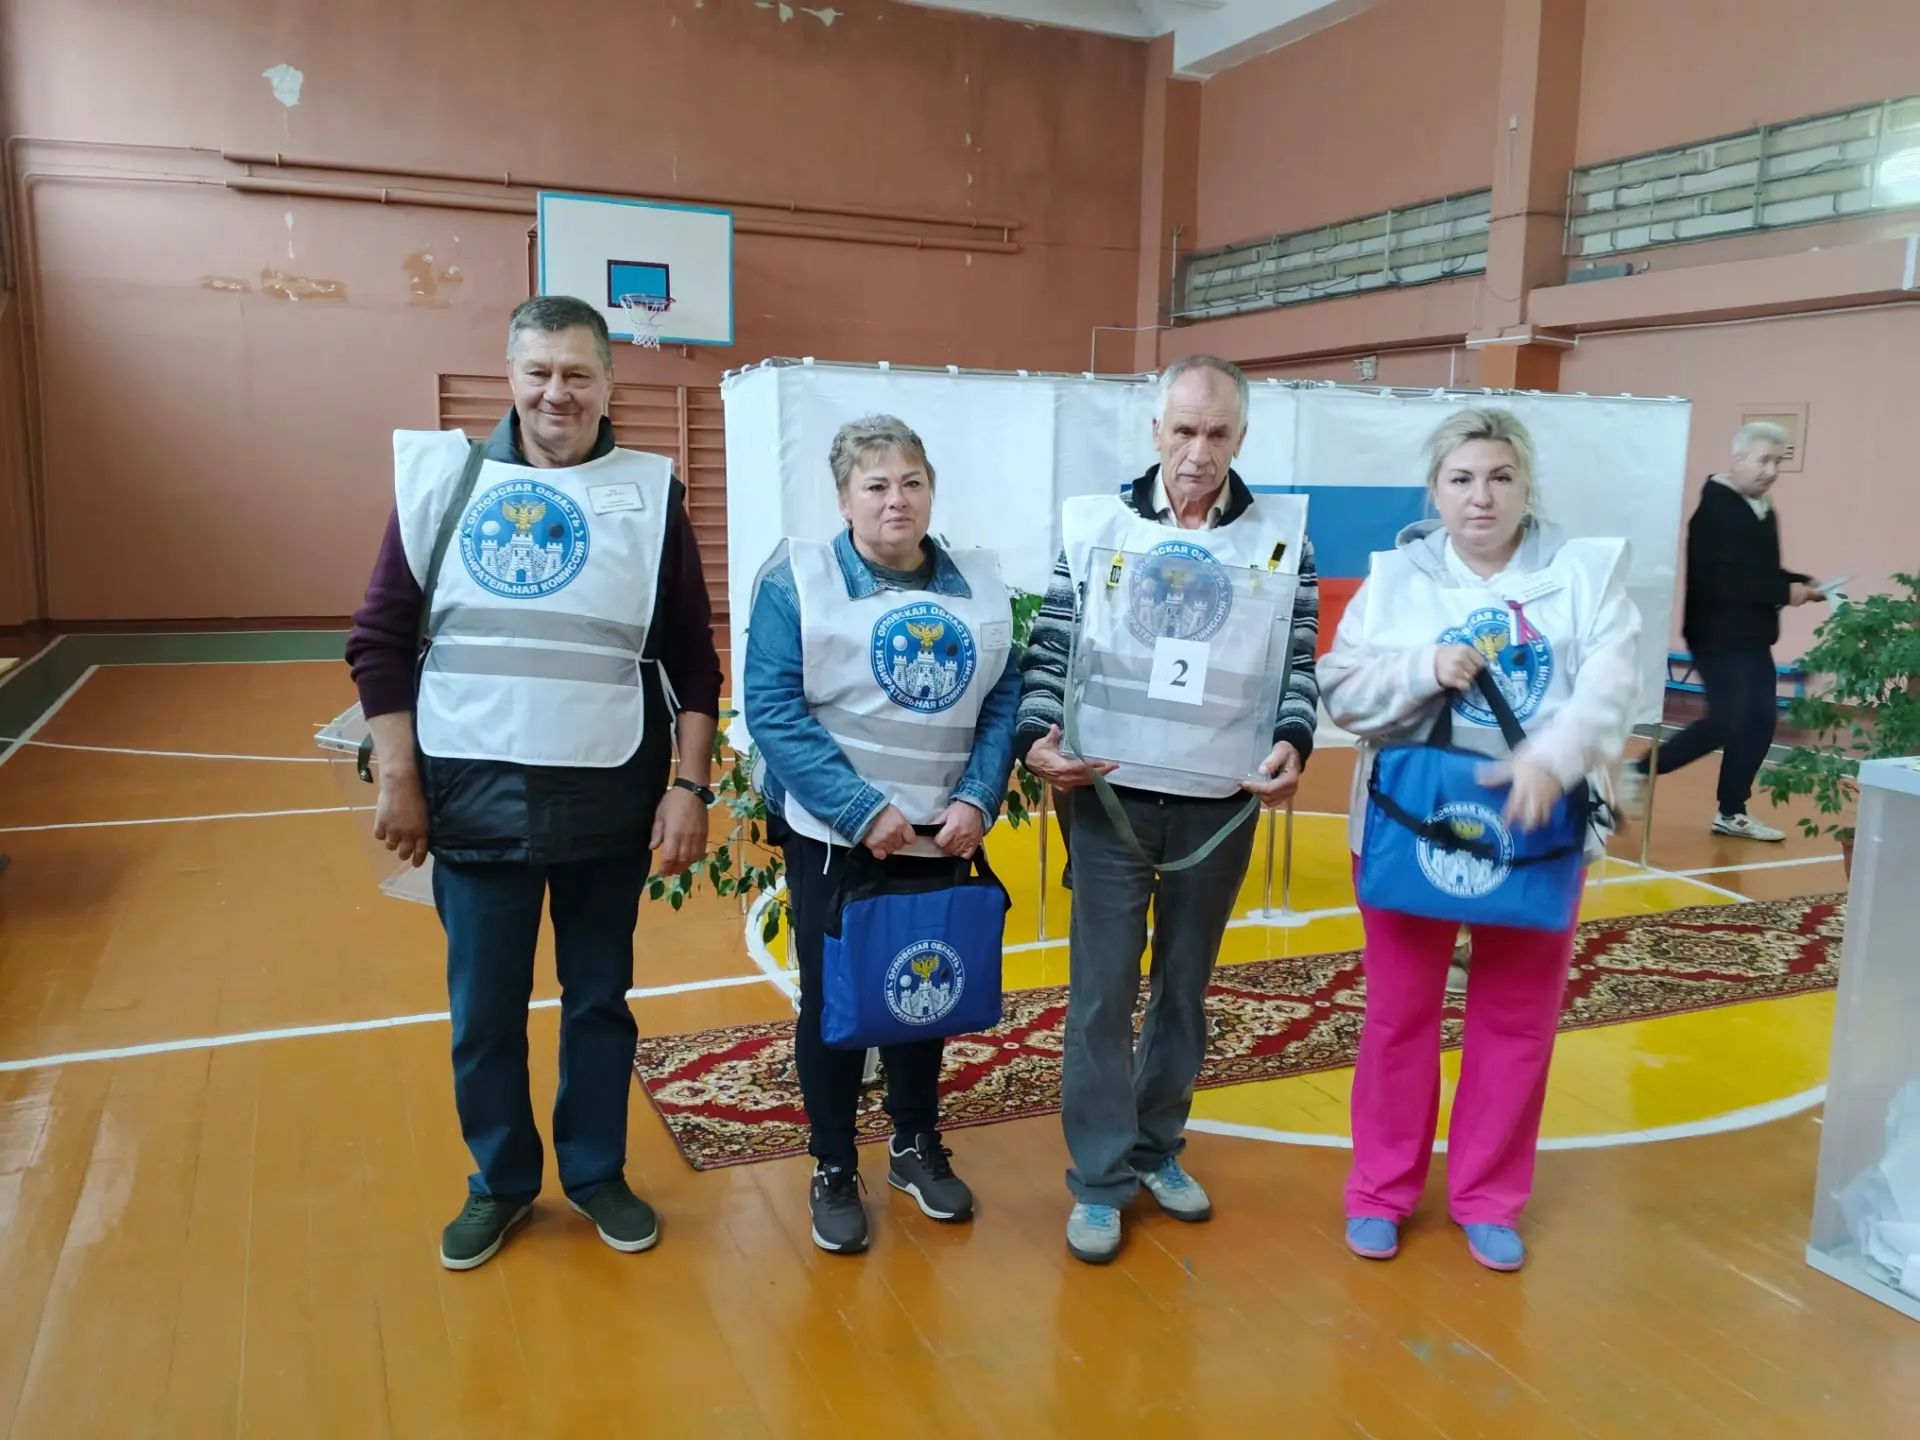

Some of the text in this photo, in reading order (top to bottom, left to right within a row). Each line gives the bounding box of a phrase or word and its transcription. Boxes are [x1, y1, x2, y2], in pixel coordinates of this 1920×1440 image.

[467, 483, 533, 525] ОРЛОВСКАЯ
[535, 486, 580, 528] ОБЛАСТЬ
[462, 537, 585, 594] ИЗБИРАТЕЛЬНАЯ КОМИССИЯ
[878, 606, 927, 637] ОРЛОВСКАЯ
[930, 607, 970, 646] ОБЛАСТЬ
[1192, 600, 1229, 641] ОМИССИЯ
[874, 649, 973, 709] ИЗБИРАТЕЛЬНАЯ КОМИССИЯ
[1169, 659, 1189, 687] 2
[888, 942, 961, 980] ОРЛОВСКАЯ ОБЛАСТЬ
